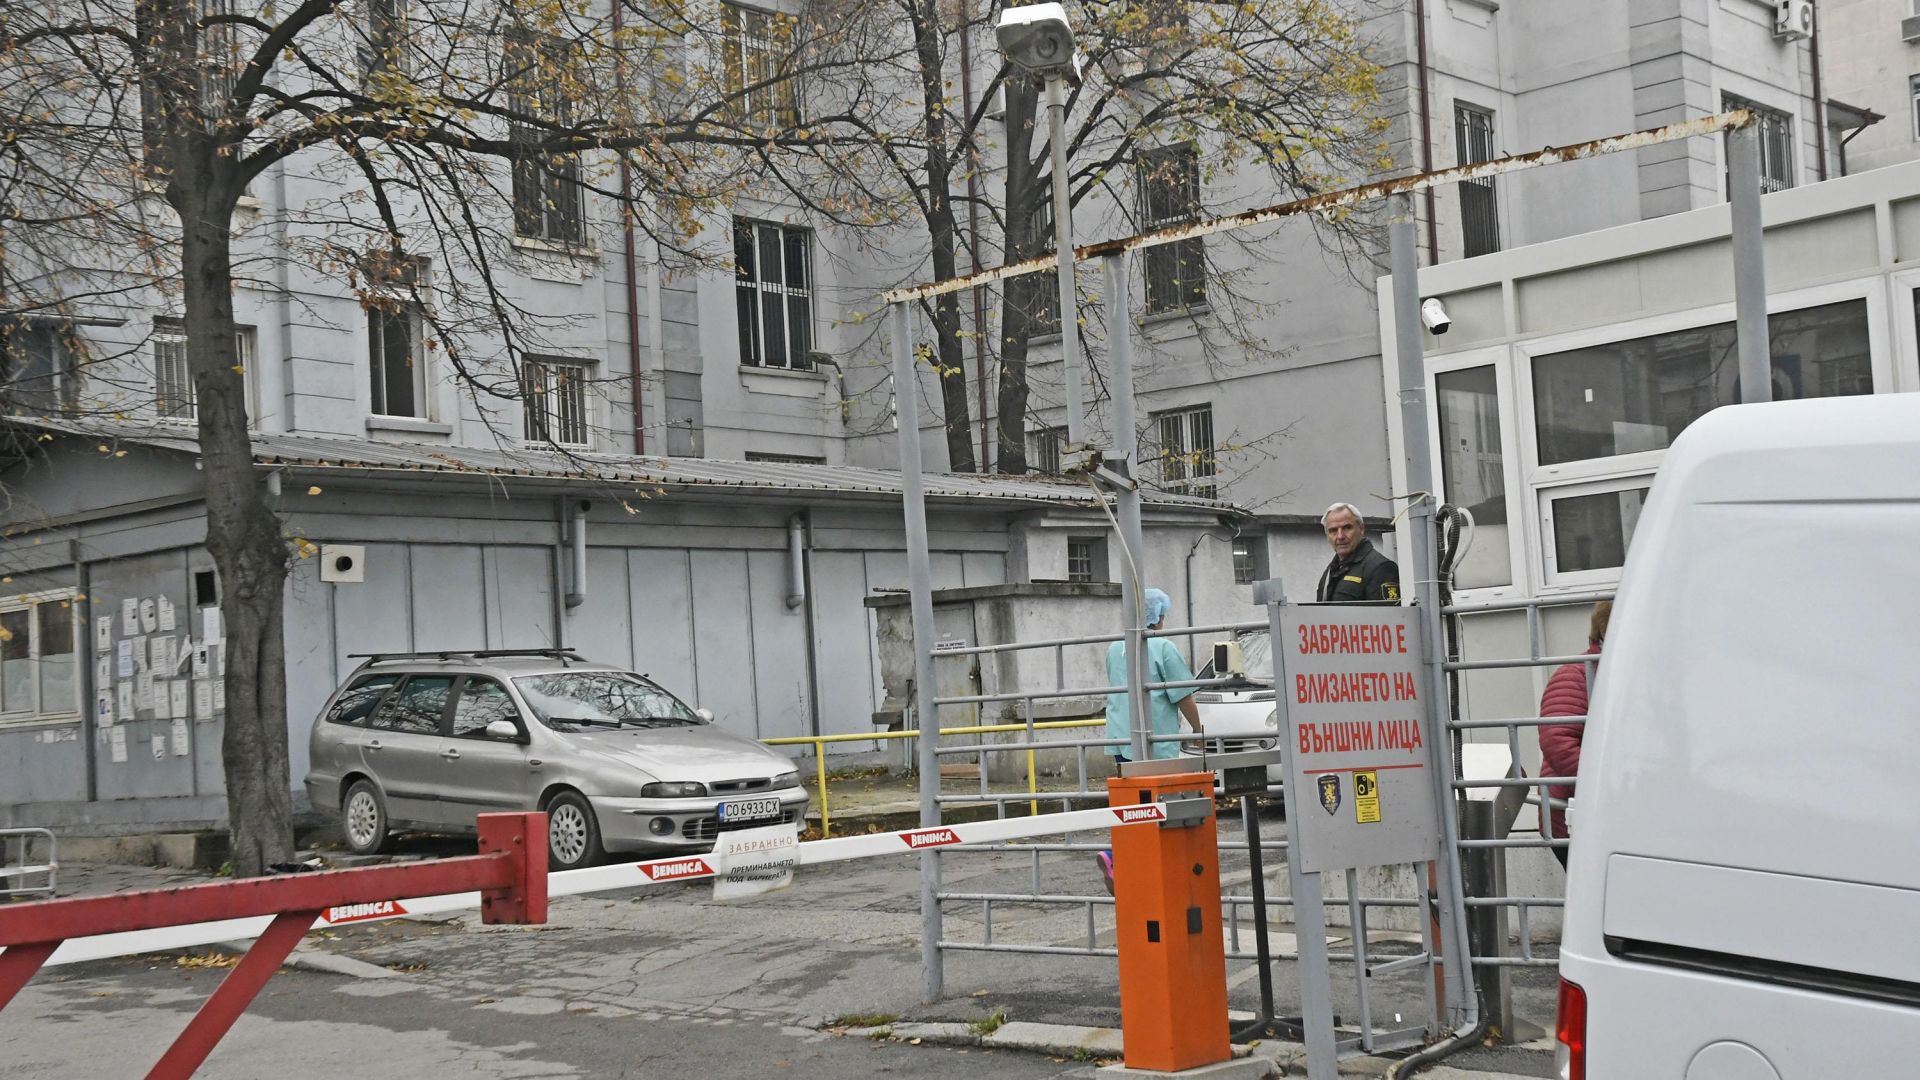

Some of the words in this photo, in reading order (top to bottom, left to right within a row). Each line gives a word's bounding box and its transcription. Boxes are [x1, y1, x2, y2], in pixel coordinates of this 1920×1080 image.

[1298, 624, 1391, 654] ЗАБРАНЕНО
[1396, 624, 1407, 654] Е
[1296, 672, 1390, 704] ВЛИЗАНЕТО
[1393, 671, 1416, 701] НА
[1298, 721, 1374, 753] ВЪНШНИ
[1377, 719, 1422, 754] ЛИЦА
[1122, 808, 1157, 822] BENINCA
[729, 836, 793, 854] ЗАБРАНЕНО
[911, 831, 952, 848] BENINCA
[652, 861, 703, 880] BENINCA
[730, 858, 794, 875] ПРЕМИНАВАНЕТО
[726, 874, 744, 883] ПОД
[329, 900, 394, 923] BENINCA
